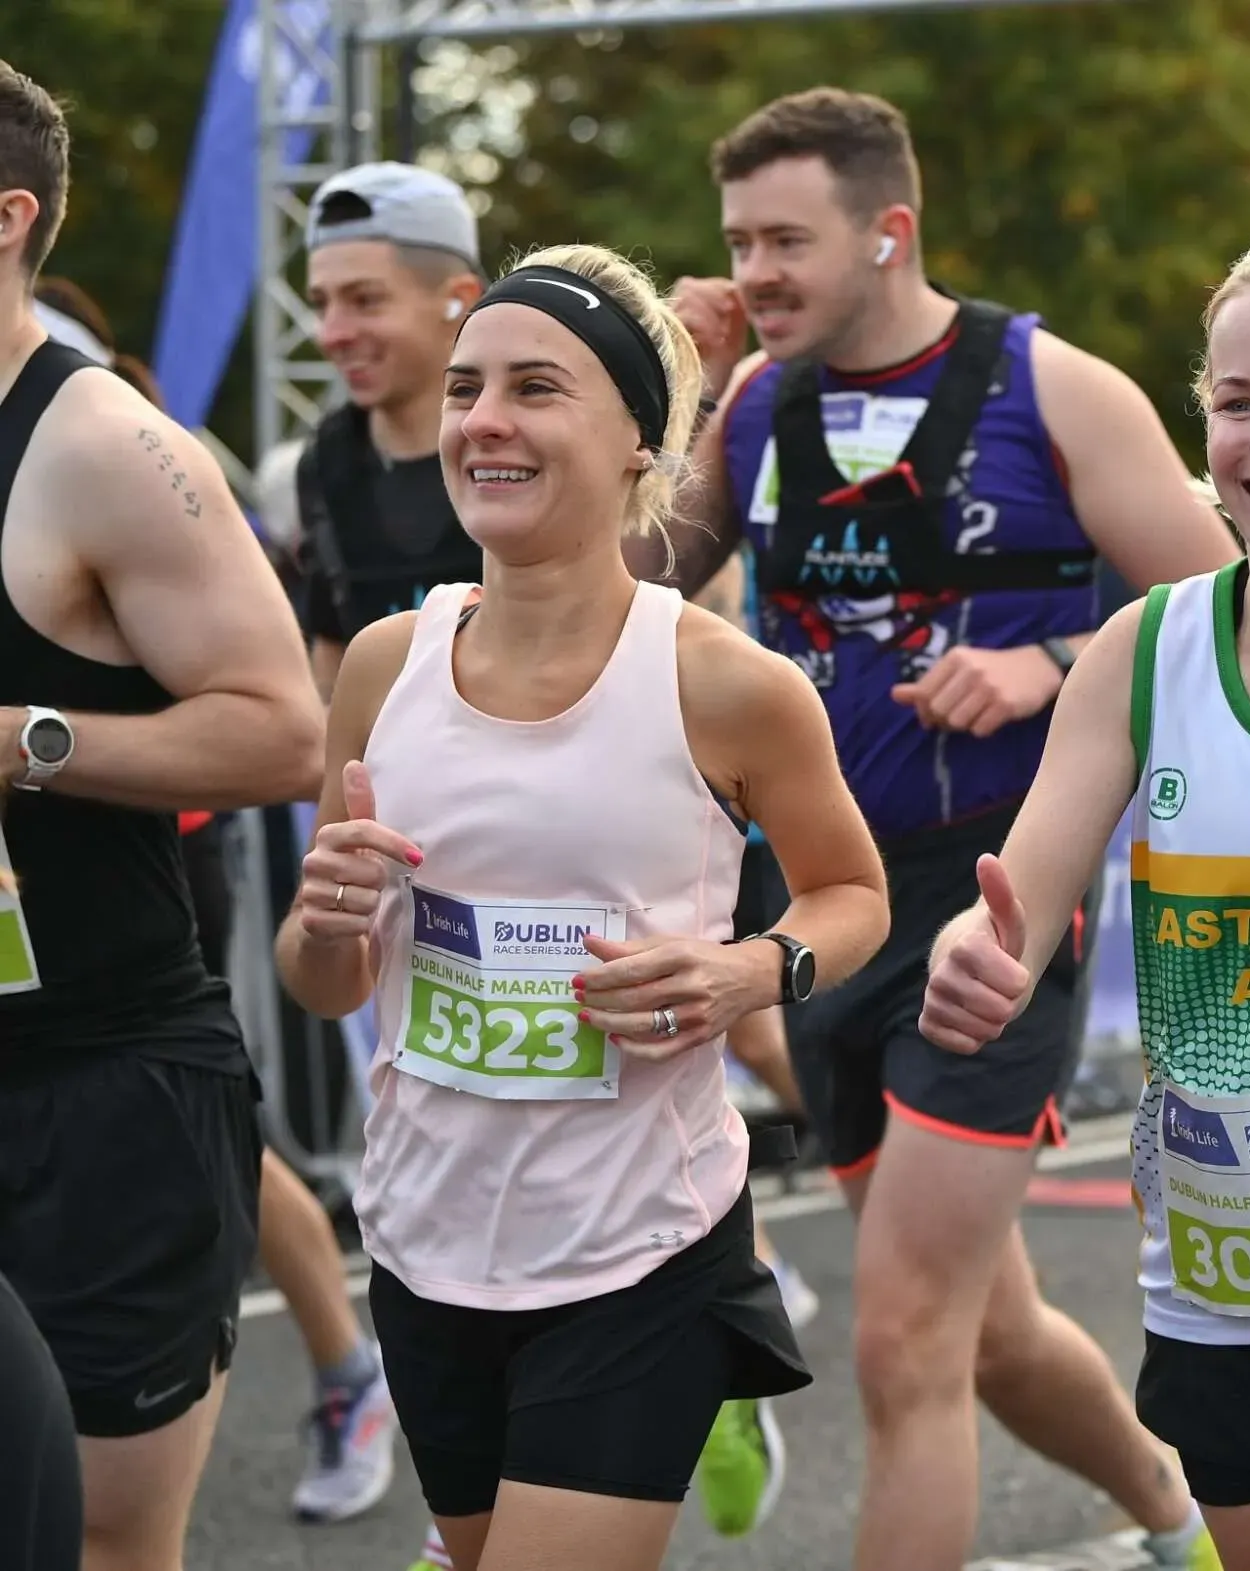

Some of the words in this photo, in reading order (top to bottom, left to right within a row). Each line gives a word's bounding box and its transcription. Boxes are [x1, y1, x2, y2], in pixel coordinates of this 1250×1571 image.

[1158, 777, 1178, 801] B
[452, 920, 469, 939] Life
[494, 921, 591, 943] DUBLIN
[494, 945, 522, 955] RACE
[524, 946, 562, 956] SERIES
[411, 955, 453, 981] DUBLIN
[455, 971, 485, 992] HALF
[491, 980, 574, 996] MARATH
[422, 990, 580, 1072] 5323
[1196, 1131, 1220, 1148] Life
[1169, 1177, 1207, 1206] DUBLIN
